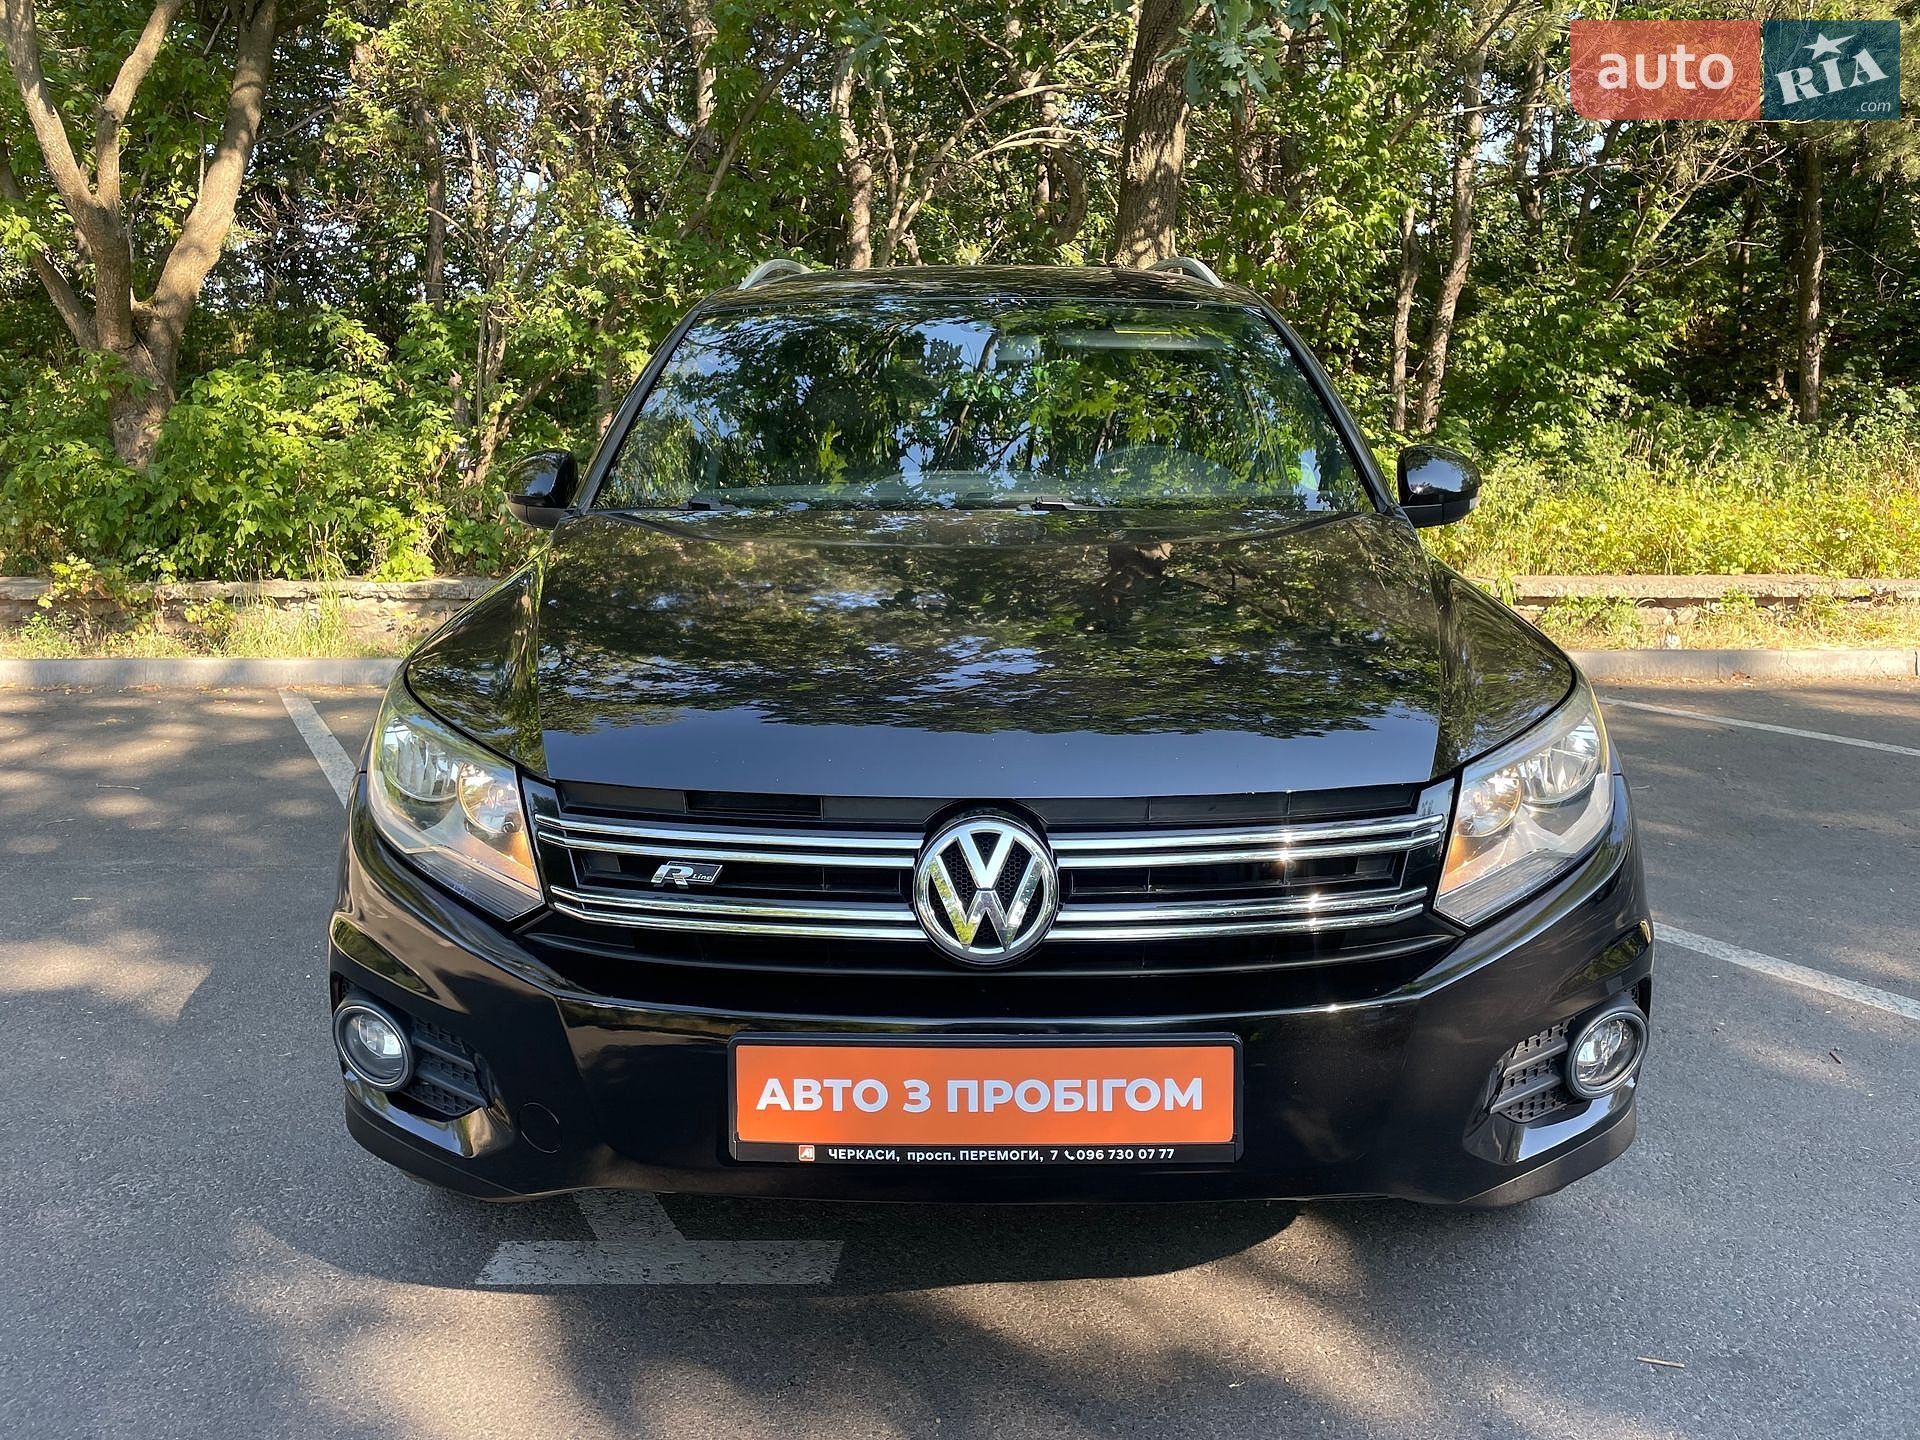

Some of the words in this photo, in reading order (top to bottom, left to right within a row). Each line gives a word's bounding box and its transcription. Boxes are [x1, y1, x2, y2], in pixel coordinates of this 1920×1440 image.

[651, 865, 693, 885] R
[755, 1078, 889, 1112] АВТО
[947, 1077, 1203, 1113] ПРОБІГОМ
[828, 1148, 900, 1162] ЧЕРКАСИ,
[907, 1151, 956, 1163] просп.
[959, 1150, 1044, 1162] ПЕРЕМОГИ,
[1050, 1150, 1059, 1160] 7
[1076, 1149, 1105, 1160] 096
[1108, 1149, 1134, 1160] 730
[1138, 1149, 1156, 1160] 07
[1158, 1148, 1175, 1159] 77
